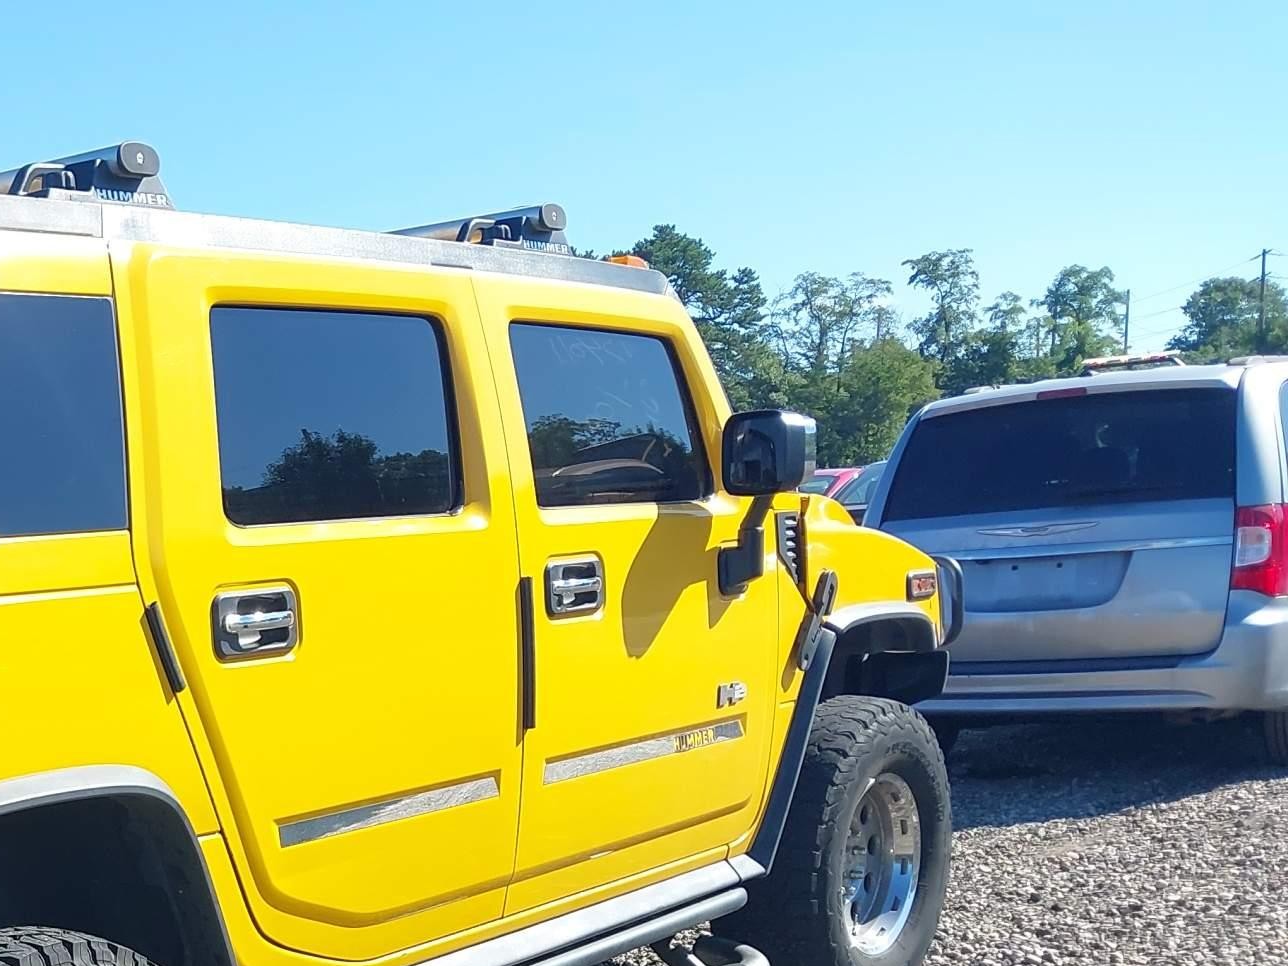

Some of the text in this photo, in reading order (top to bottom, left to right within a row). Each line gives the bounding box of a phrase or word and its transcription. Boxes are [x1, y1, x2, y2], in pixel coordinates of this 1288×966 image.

[96, 188, 168, 205] HUMMER
[523, 239, 569, 255] HUMMER
[716, 682, 746, 710] H2
[673, 726, 716, 753] HUMMER
